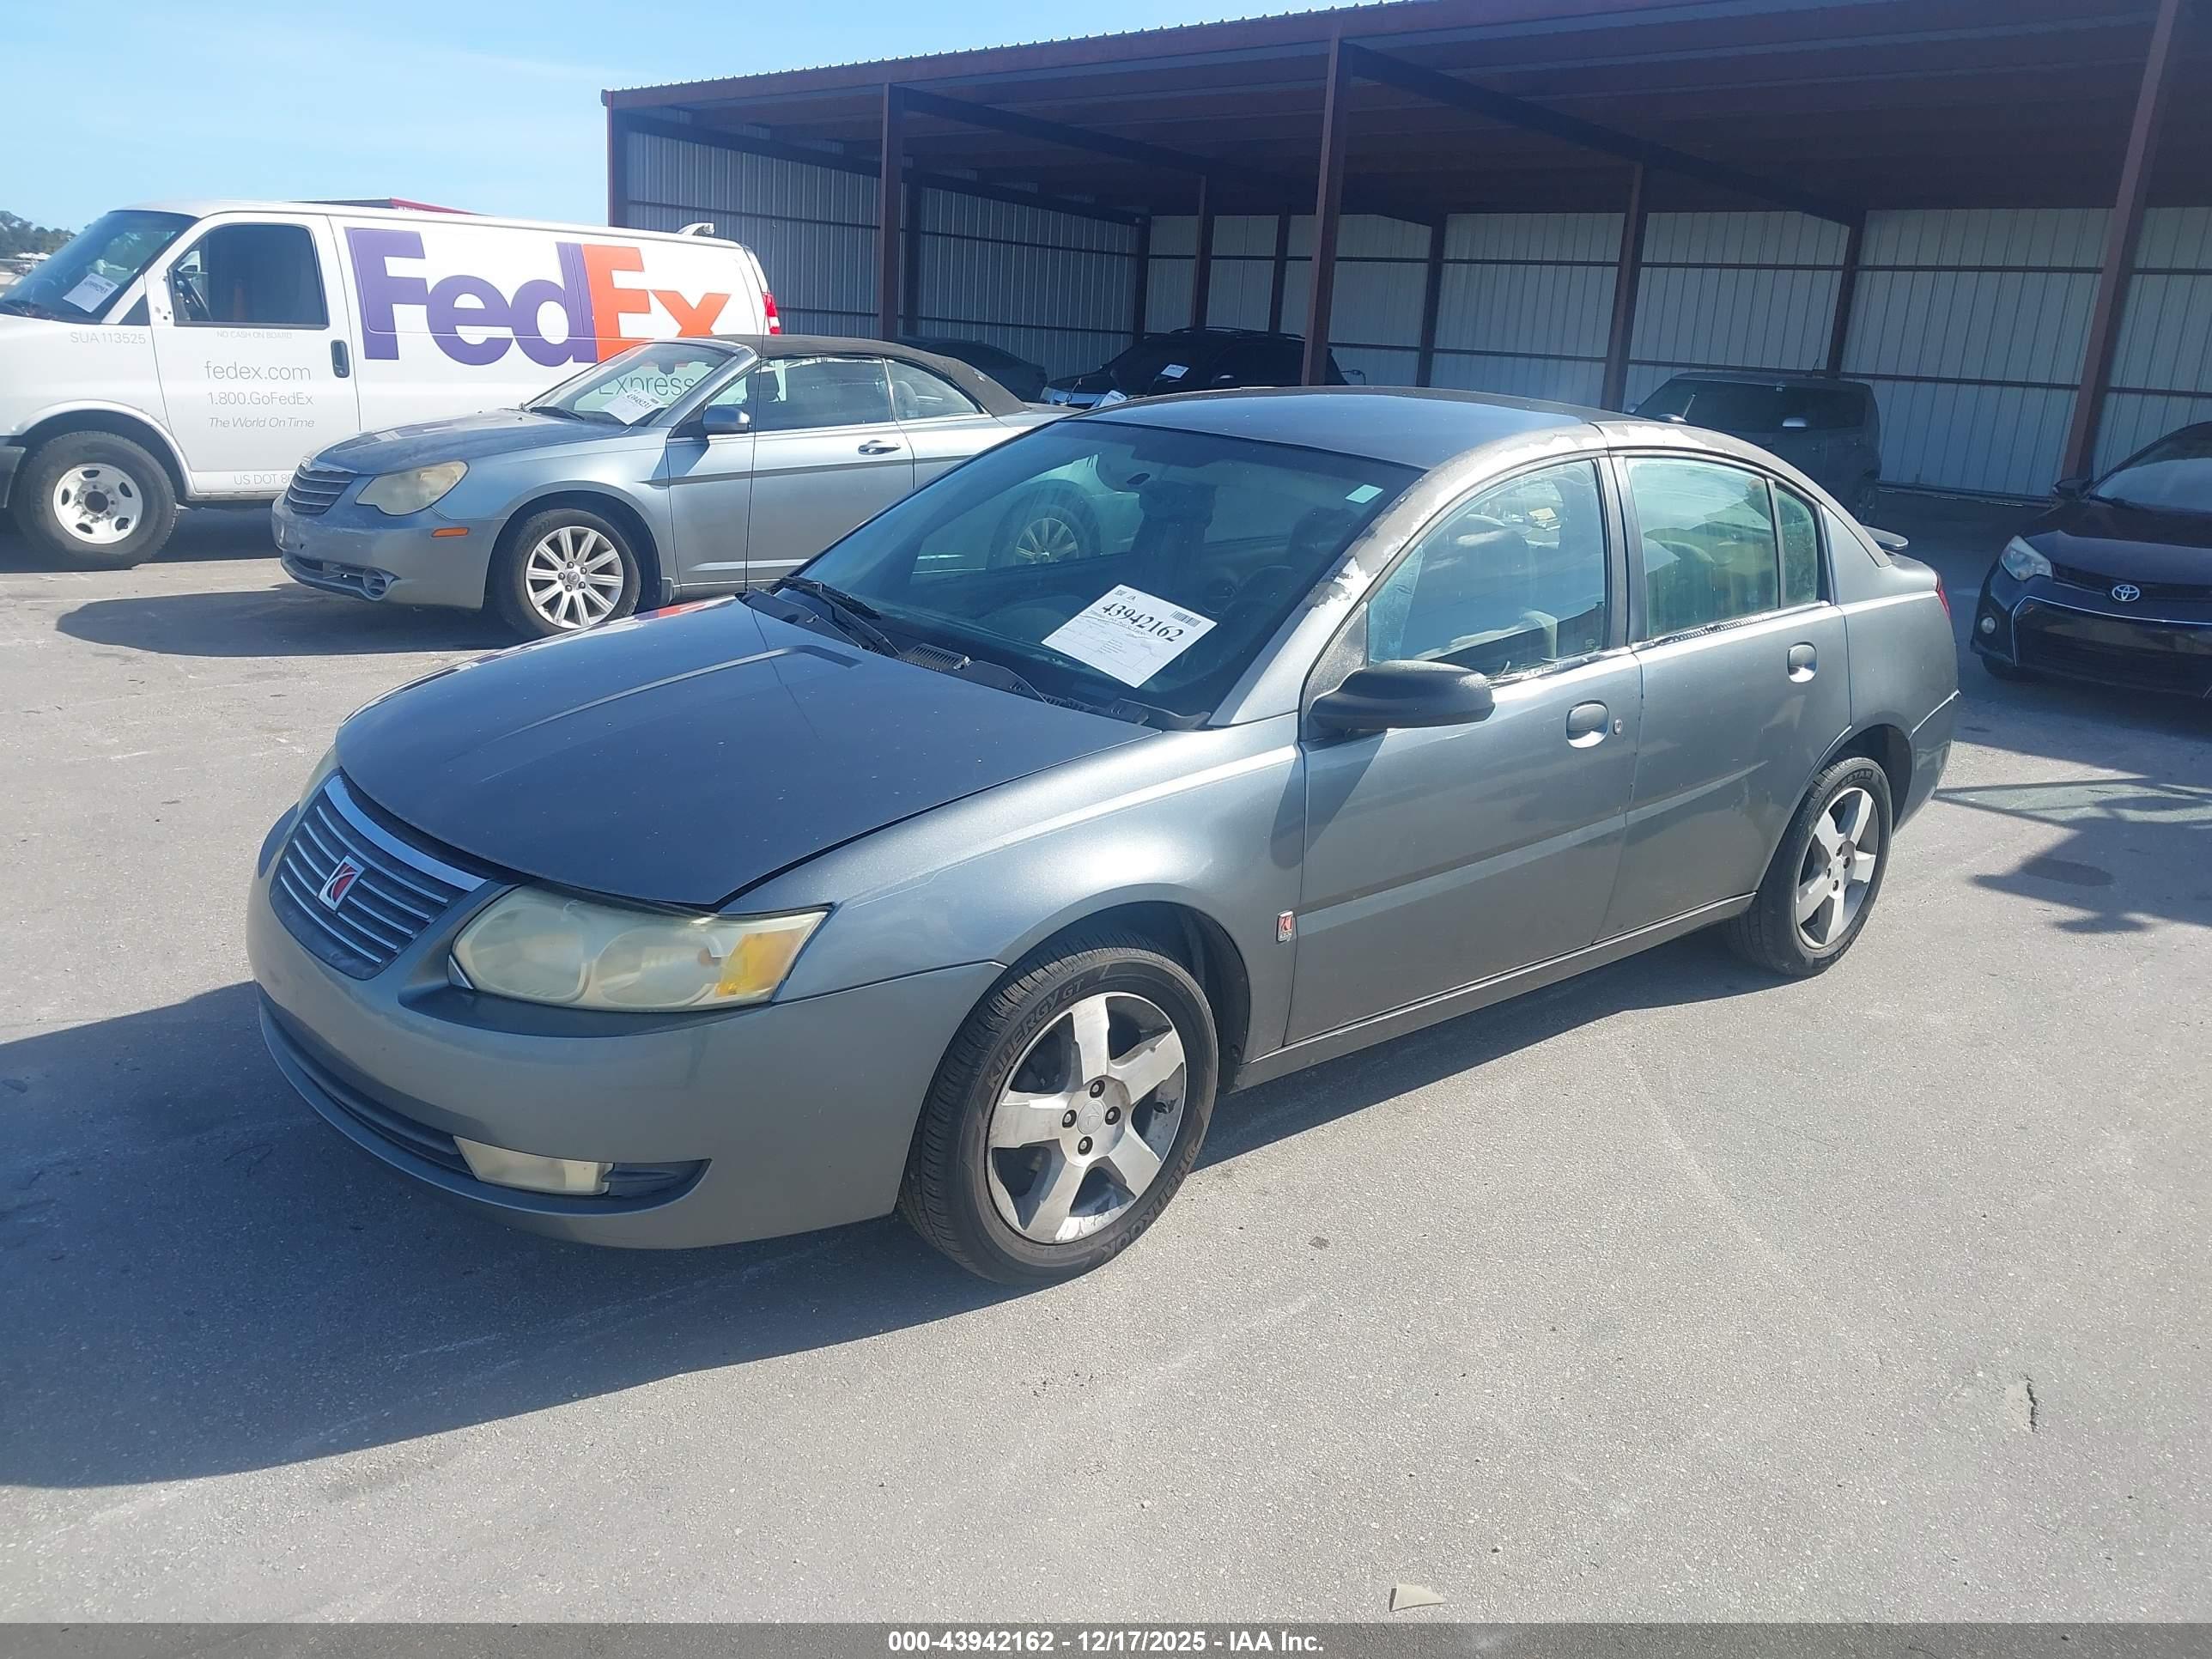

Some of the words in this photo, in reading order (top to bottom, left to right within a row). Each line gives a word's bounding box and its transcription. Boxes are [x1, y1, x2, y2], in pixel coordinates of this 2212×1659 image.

[346, 228, 731, 367] FedEx
[230, 330, 251, 338] CASH
[204, 361, 311, 380] fedex.com
[207, 392, 314, 405] 1.800.GoFedEx
[209, 416, 230, 428] The
[232, 416, 266, 428] World
[269, 417, 286, 428] On
[288, 417, 315, 428] Time
[234, 474, 251, 485] US
[253, 473, 277, 484] DOT
[1101, 602, 1185, 643] 43942162
